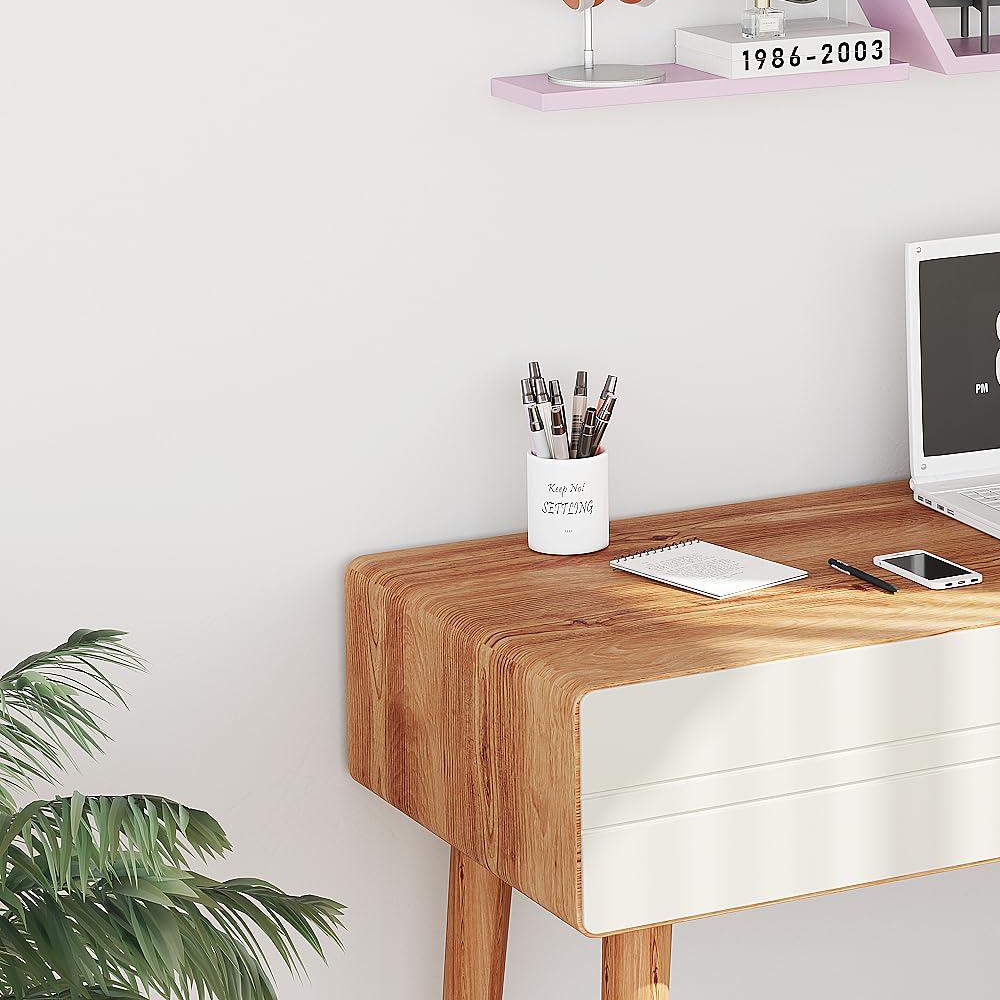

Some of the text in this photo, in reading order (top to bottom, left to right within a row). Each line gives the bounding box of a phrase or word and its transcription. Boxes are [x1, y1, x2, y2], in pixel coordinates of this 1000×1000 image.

[742, 39, 884, 71] 1986-2003
[975, 382, 989, 394] PM
[547, 483, 568, 498] Keep
[541, 499, 594, 515] SETTLING
